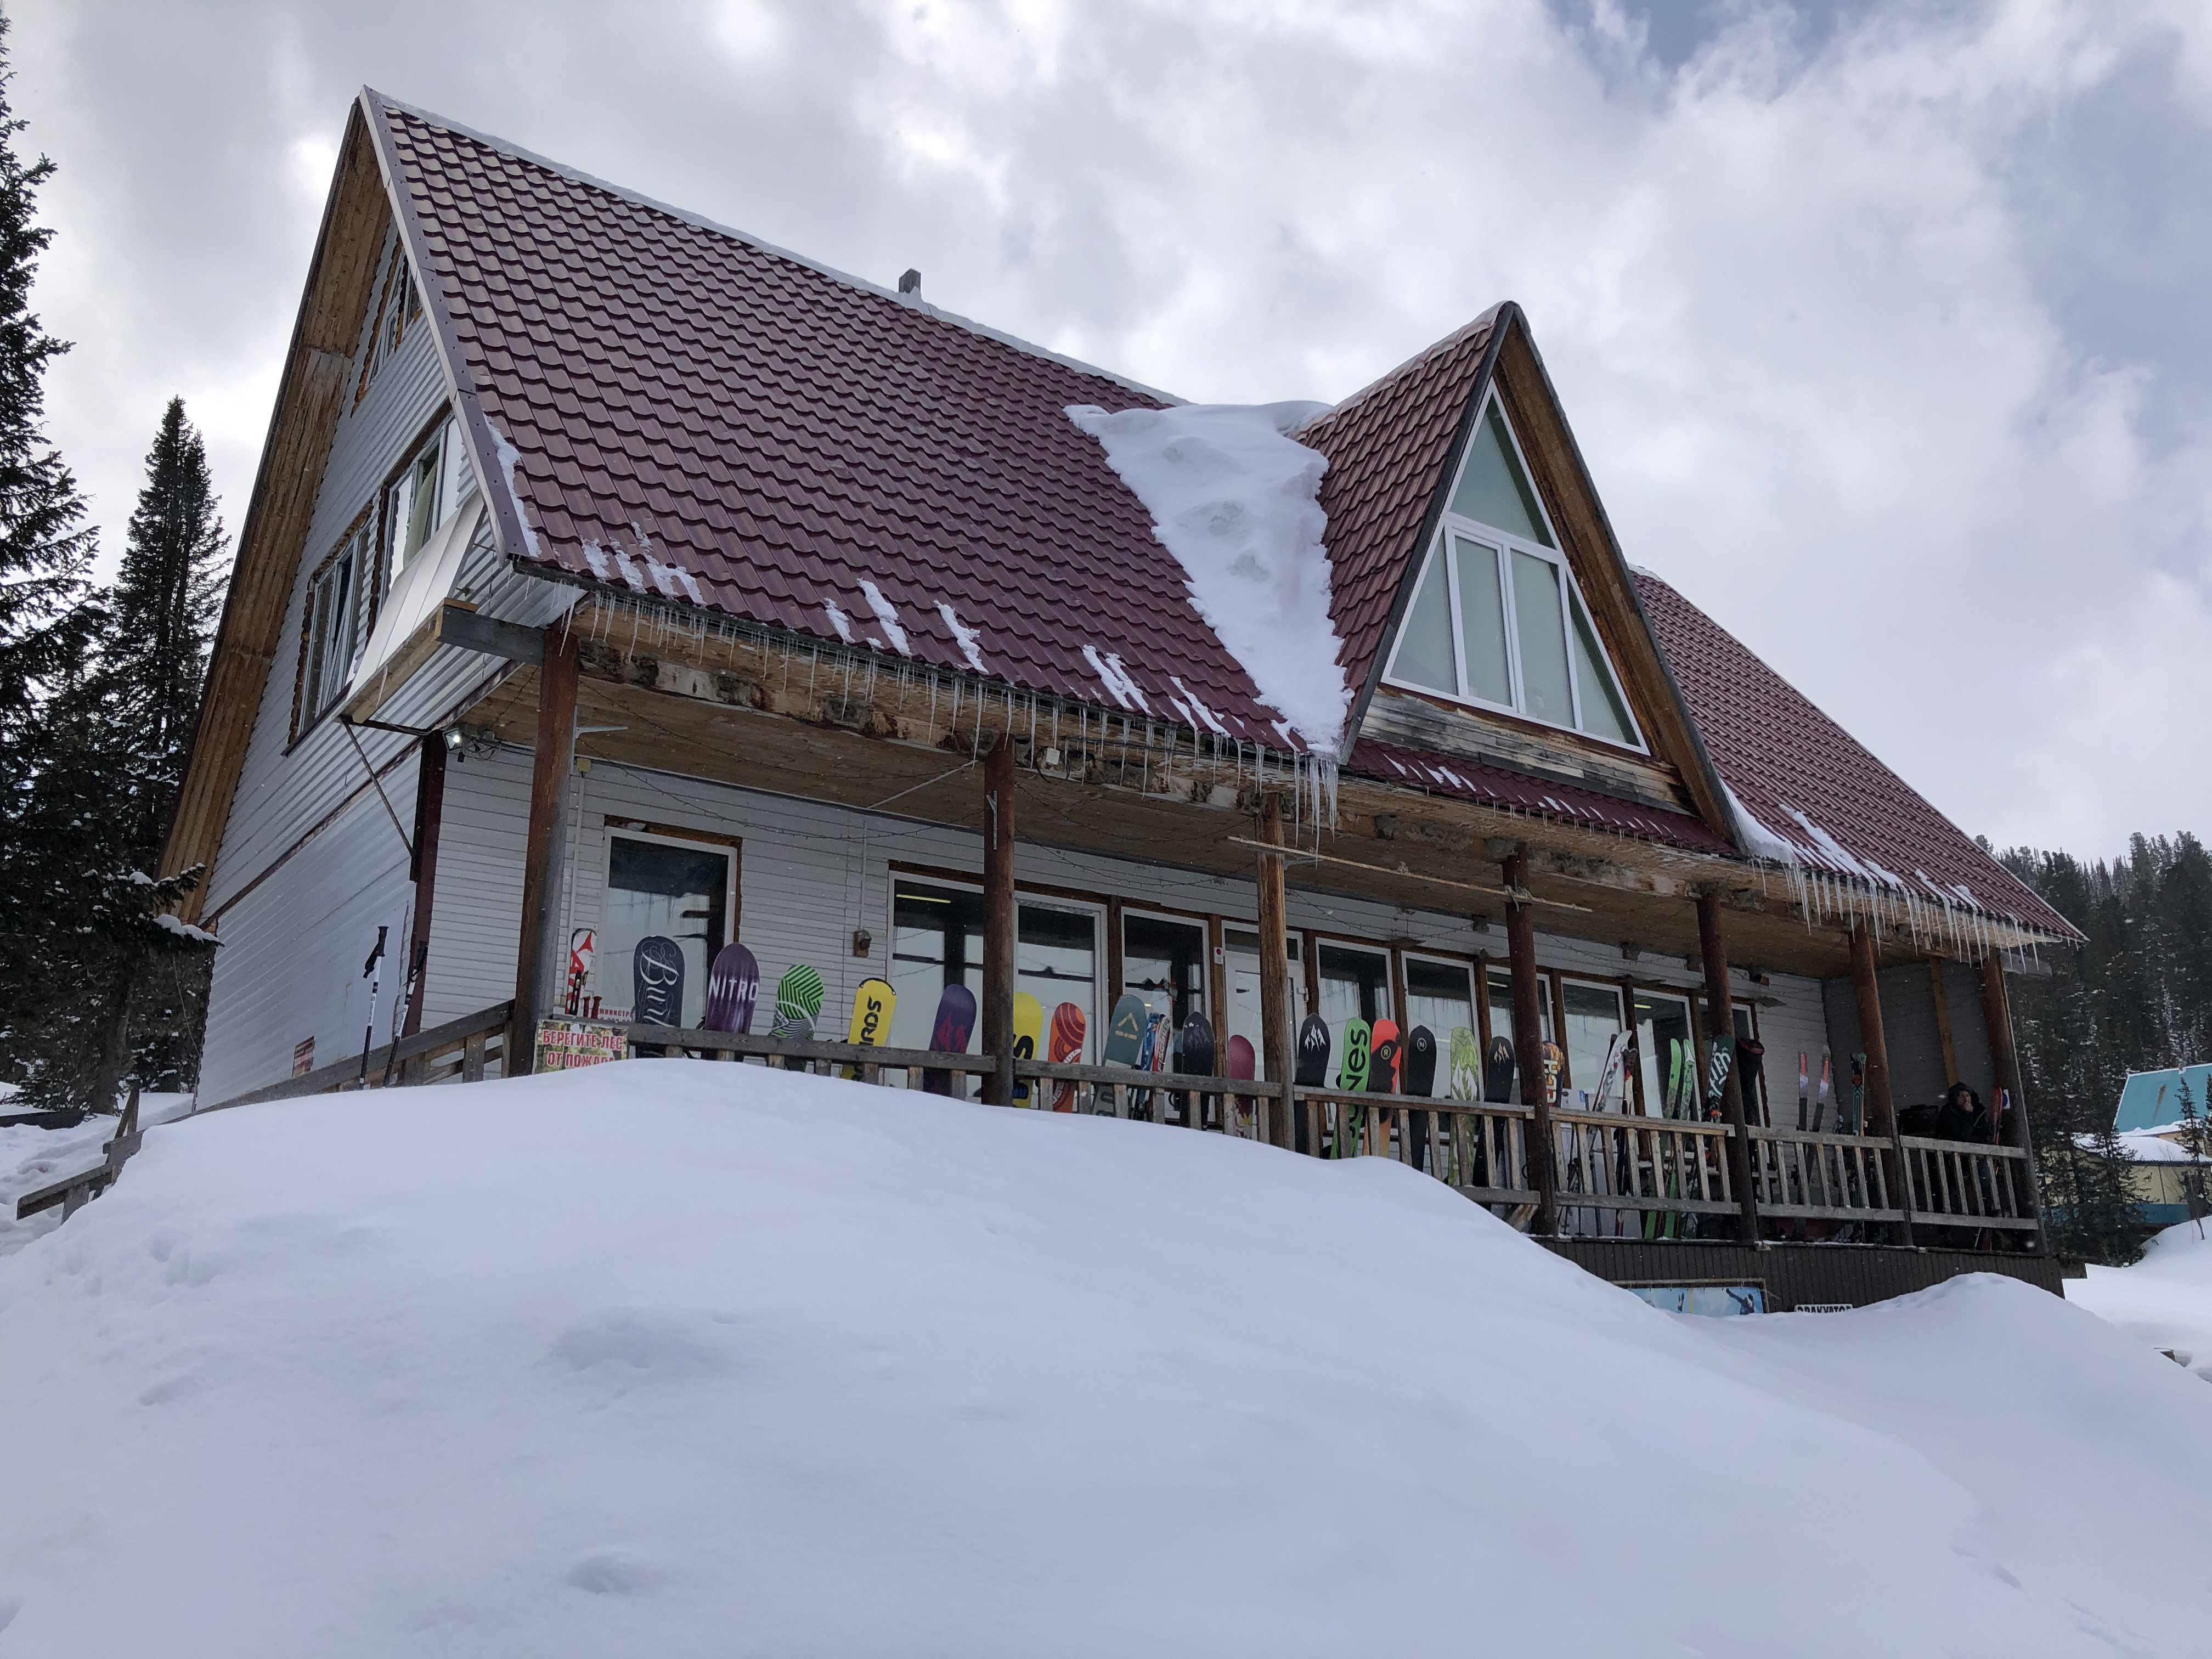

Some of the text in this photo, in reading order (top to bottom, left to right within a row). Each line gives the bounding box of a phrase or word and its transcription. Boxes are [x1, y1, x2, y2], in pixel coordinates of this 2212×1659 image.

[709, 974, 759, 1001] NITRO
[543, 1030, 623, 1050] БЕРЕГИТЕ ЛЕС
[1157, 1018, 1171, 1070] FISCHER
[548, 1052, 562, 1065] ОТ
